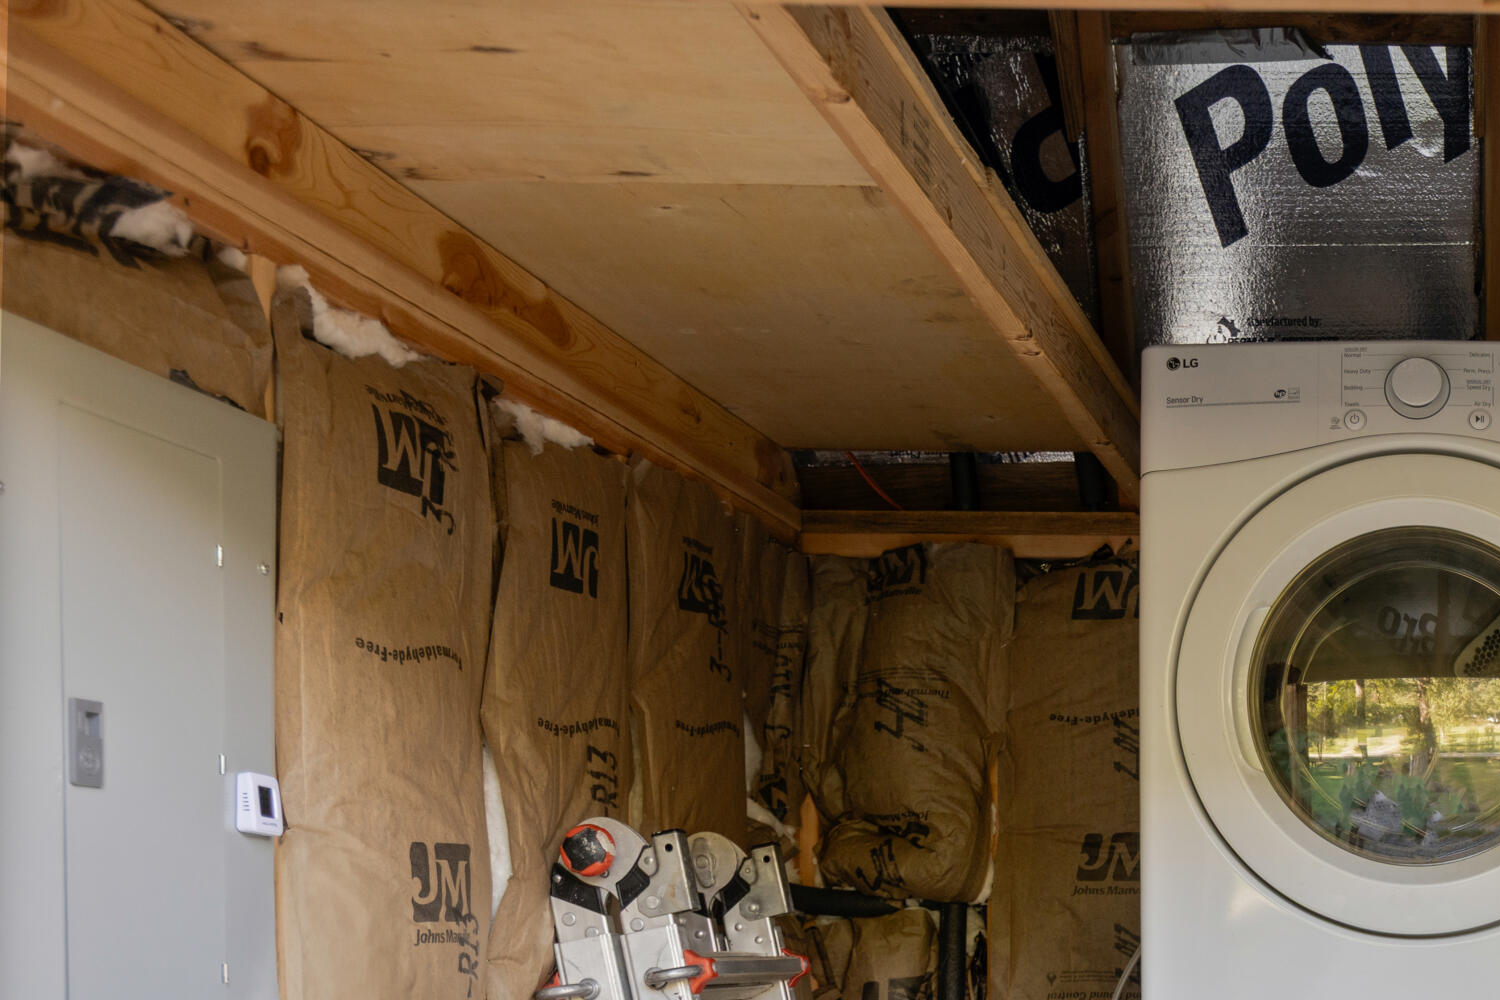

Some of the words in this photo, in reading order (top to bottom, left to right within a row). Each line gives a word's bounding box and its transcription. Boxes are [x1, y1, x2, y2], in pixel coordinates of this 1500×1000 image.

[1182, 358, 1199, 369] LG
[550, 517, 599, 598] JM
[410, 842, 472, 923] JM
